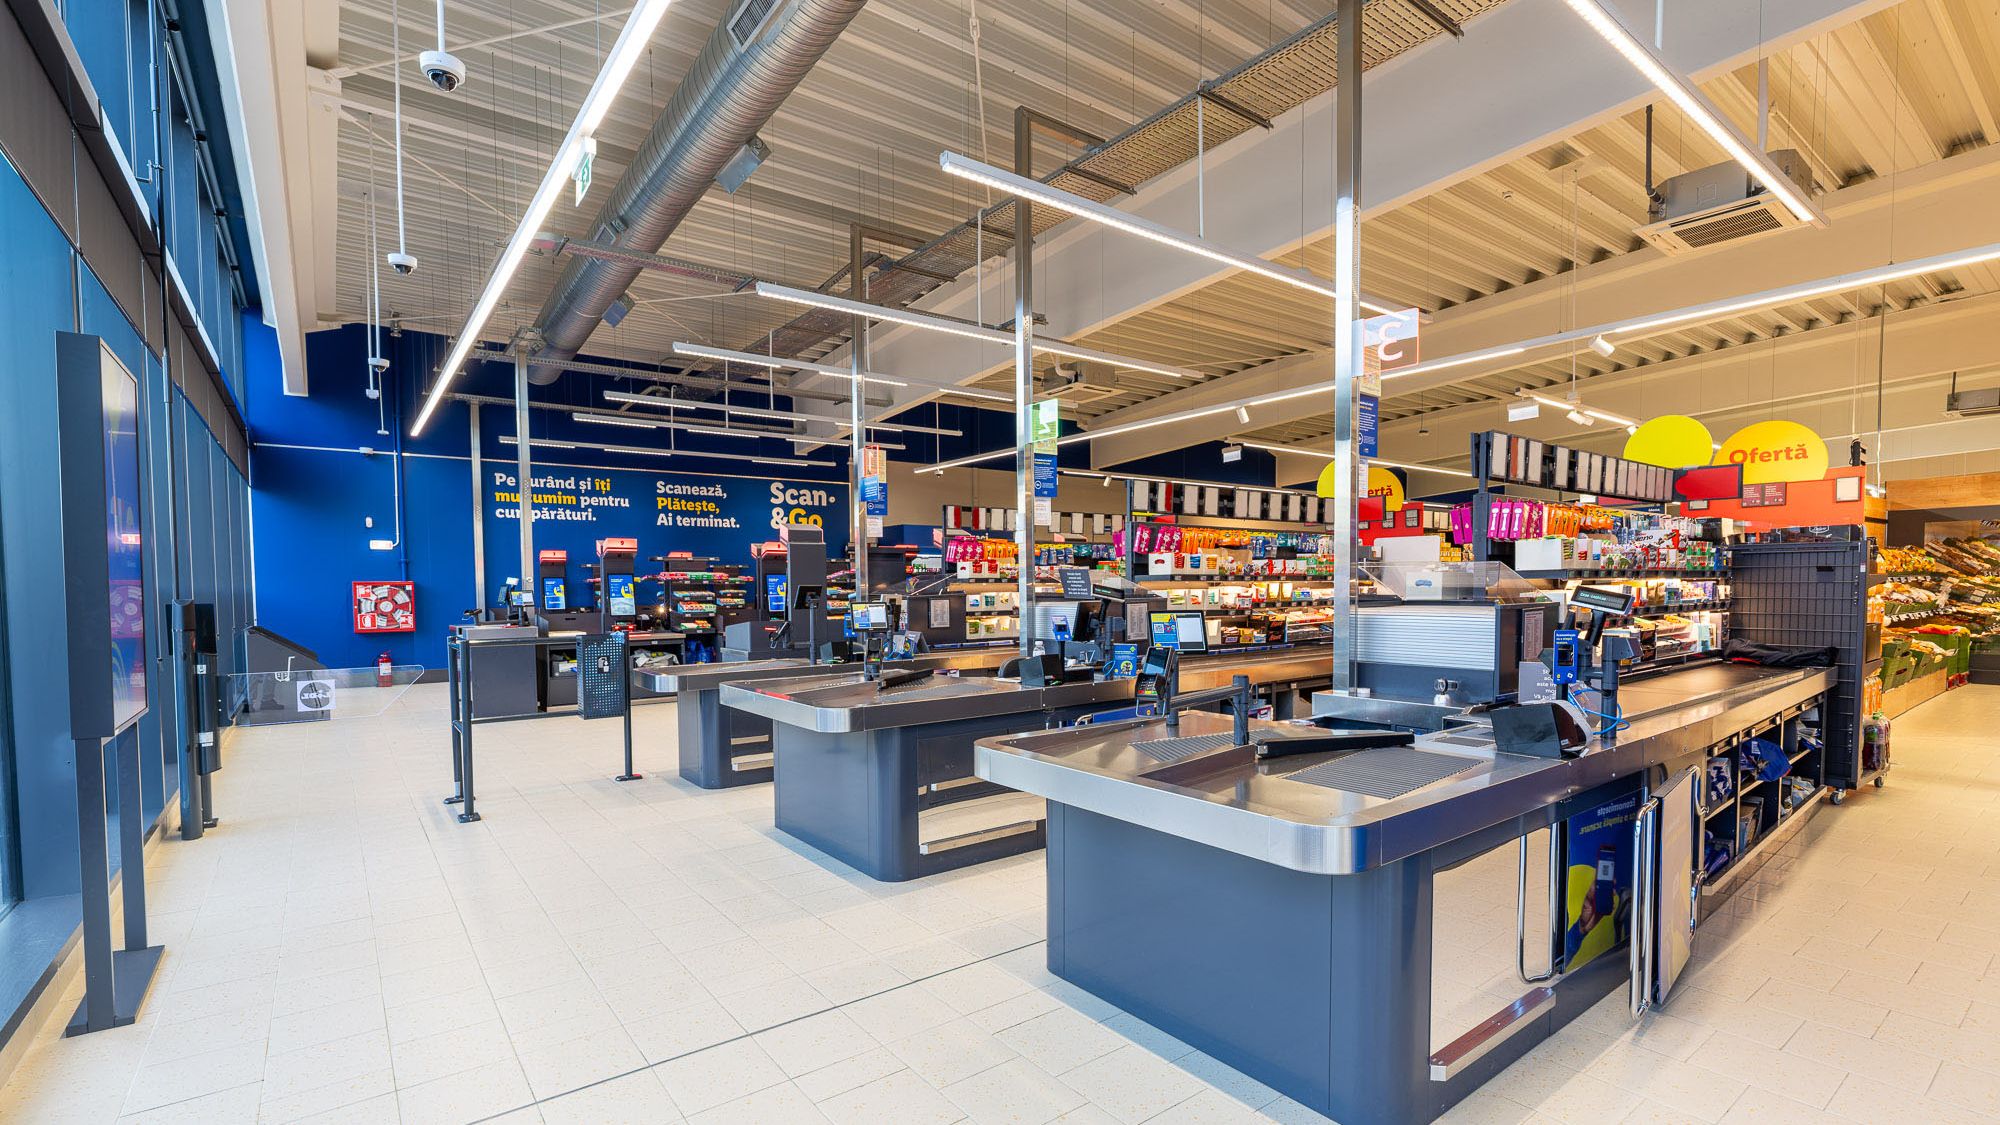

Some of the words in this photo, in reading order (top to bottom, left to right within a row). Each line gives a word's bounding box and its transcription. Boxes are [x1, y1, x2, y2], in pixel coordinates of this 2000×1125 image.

[1728, 443, 1809, 465] Ofertă
[494, 472, 516, 486] Pe
[530, 475, 576, 490] urând
[579, 477, 592, 493] și
[594, 478, 611, 494] îți
[656, 480, 727, 499] Scanează,
[1367, 485, 1393, 497] ertă
[495, 491, 577, 505] muumim
[579, 495, 630, 508] pentru
[656, 497, 720, 515] Plătește,
[656, 513, 673, 526] Ai
[676, 515, 740, 528] terminat.
